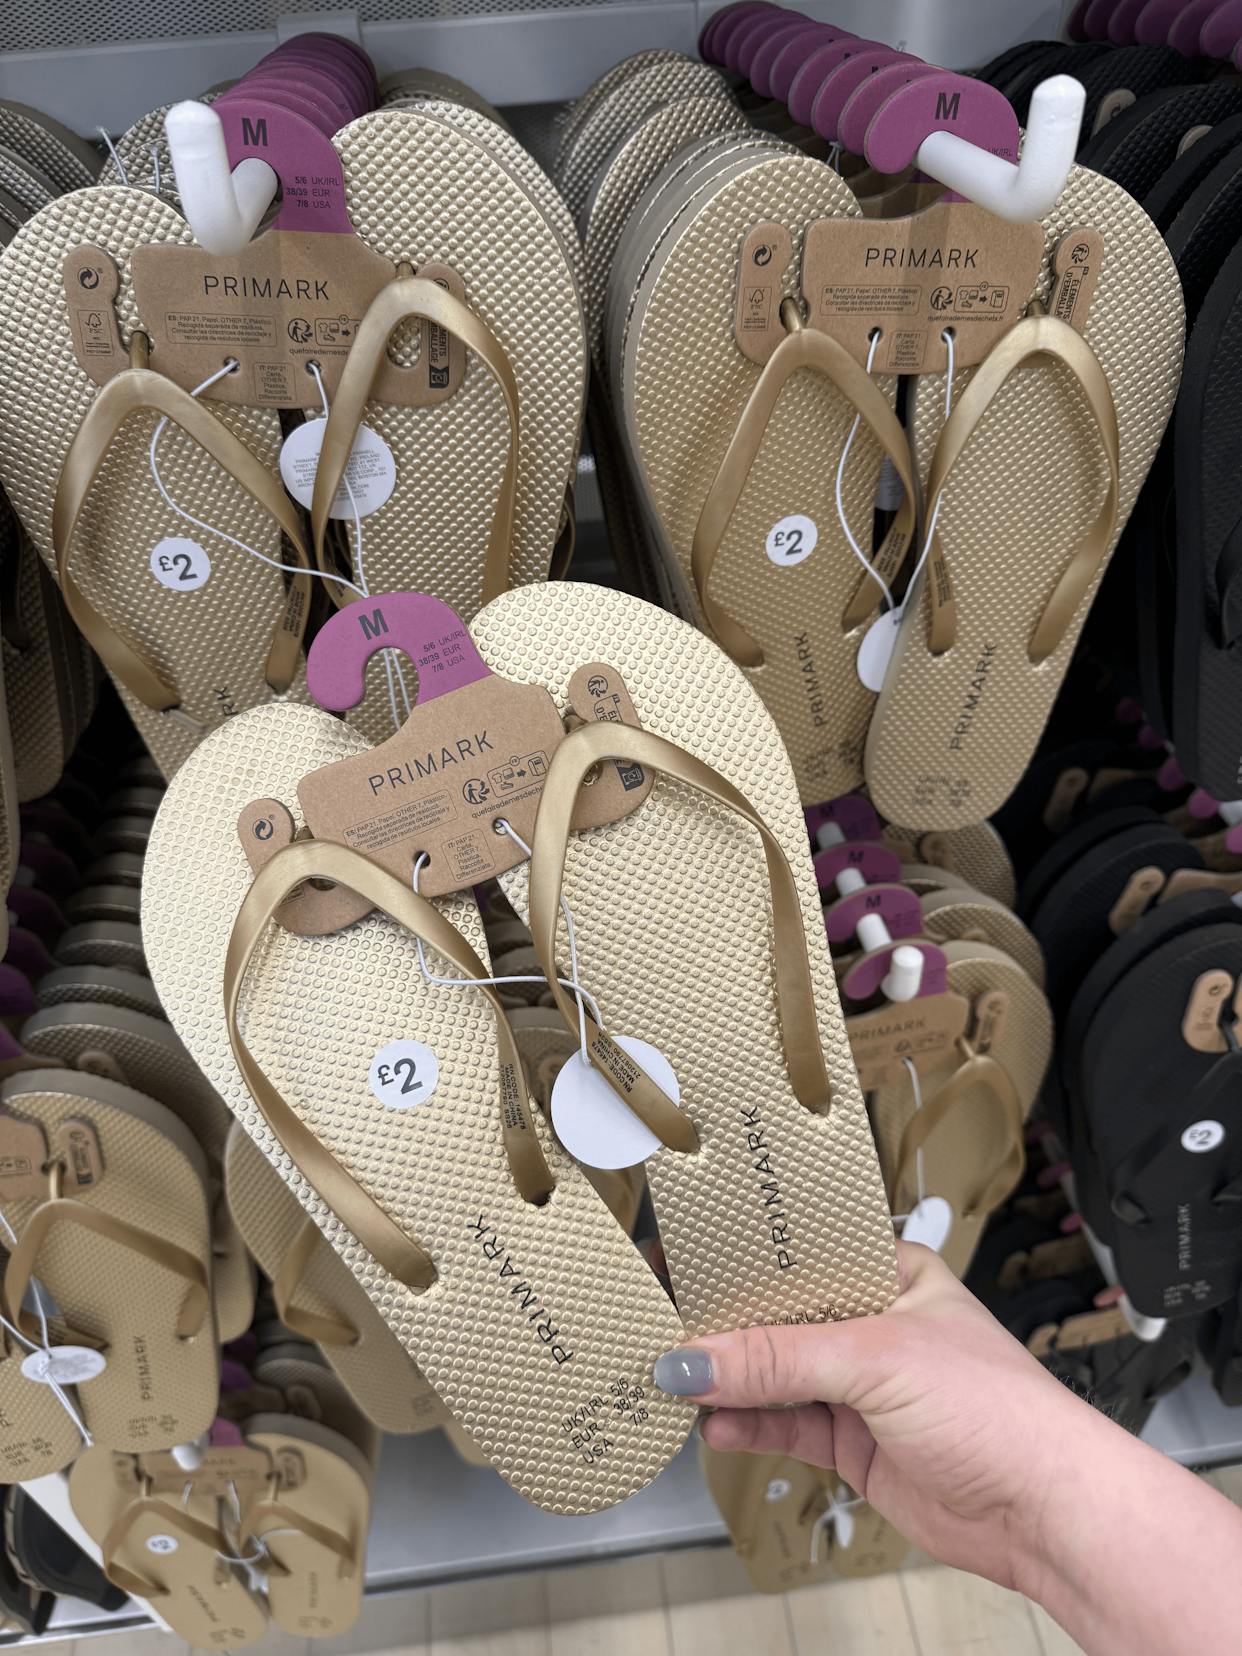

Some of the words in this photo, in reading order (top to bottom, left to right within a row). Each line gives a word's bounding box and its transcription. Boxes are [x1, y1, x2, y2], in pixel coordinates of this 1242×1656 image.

[935, 93, 960, 120] M
[242, 117, 268, 146] M
[286, 188, 308, 196] 38/39
[312, 188, 330, 197] EUR
[295, 177, 308, 185] 5/6
[311, 177, 339, 186] UK/IRL
[297, 200, 309, 208] 7/8
[312, 200, 331, 209] USA
[864, 247, 980, 270] PRIMARK
[203, 275, 330, 301] PRIMARK
[775, 529, 803, 556] £2
[158, 553, 198, 582] £2
[358, 608, 389, 640] M
[423, 641, 436, 653] 5/6
[438, 629, 466, 646] UK/IRL
[418, 652, 440, 667] 38/39
[442, 643, 461, 657] EUR
[431, 662, 444, 673] 7/8
[446, 654, 465, 668] USA
[794, 632, 827, 728] PRIMARK
[950, 643, 998, 752] PRIMARK
[368, 730, 494, 796] PRIMARK
[866, 896, 881, 909] M
[597, 1037, 614, 1059] CHINA
[608, 1062, 625, 1083] CODE:
[613, 1057, 621, 1067] IN
[619, 1066, 636, 1084] MADE
[377, 1057, 423, 1095] £2
[504, 1066, 512, 1090] MADE
[507, 1090, 513, 1101] IN
[508, 1101, 517, 1127] CHINA
[740, 1106, 797, 1270] PRIMARK
[1177, 1203, 1193, 1271] PRIMARK
[467, 1214, 574, 1366] PRIMARK
[818, 1304, 838, 1321] 5/6
[134, 1335, 152, 1401] PRIMARK
[561, 1395, 609, 1433] UK/IRL
[610, 1377, 629, 1397] 5/6
[572, 1422, 602, 1449] EUR
[613, 1385, 645, 1416] 38/39
[582, 1438, 614, 1464] USA
[629, 1407, 649, 1427] 7/8
